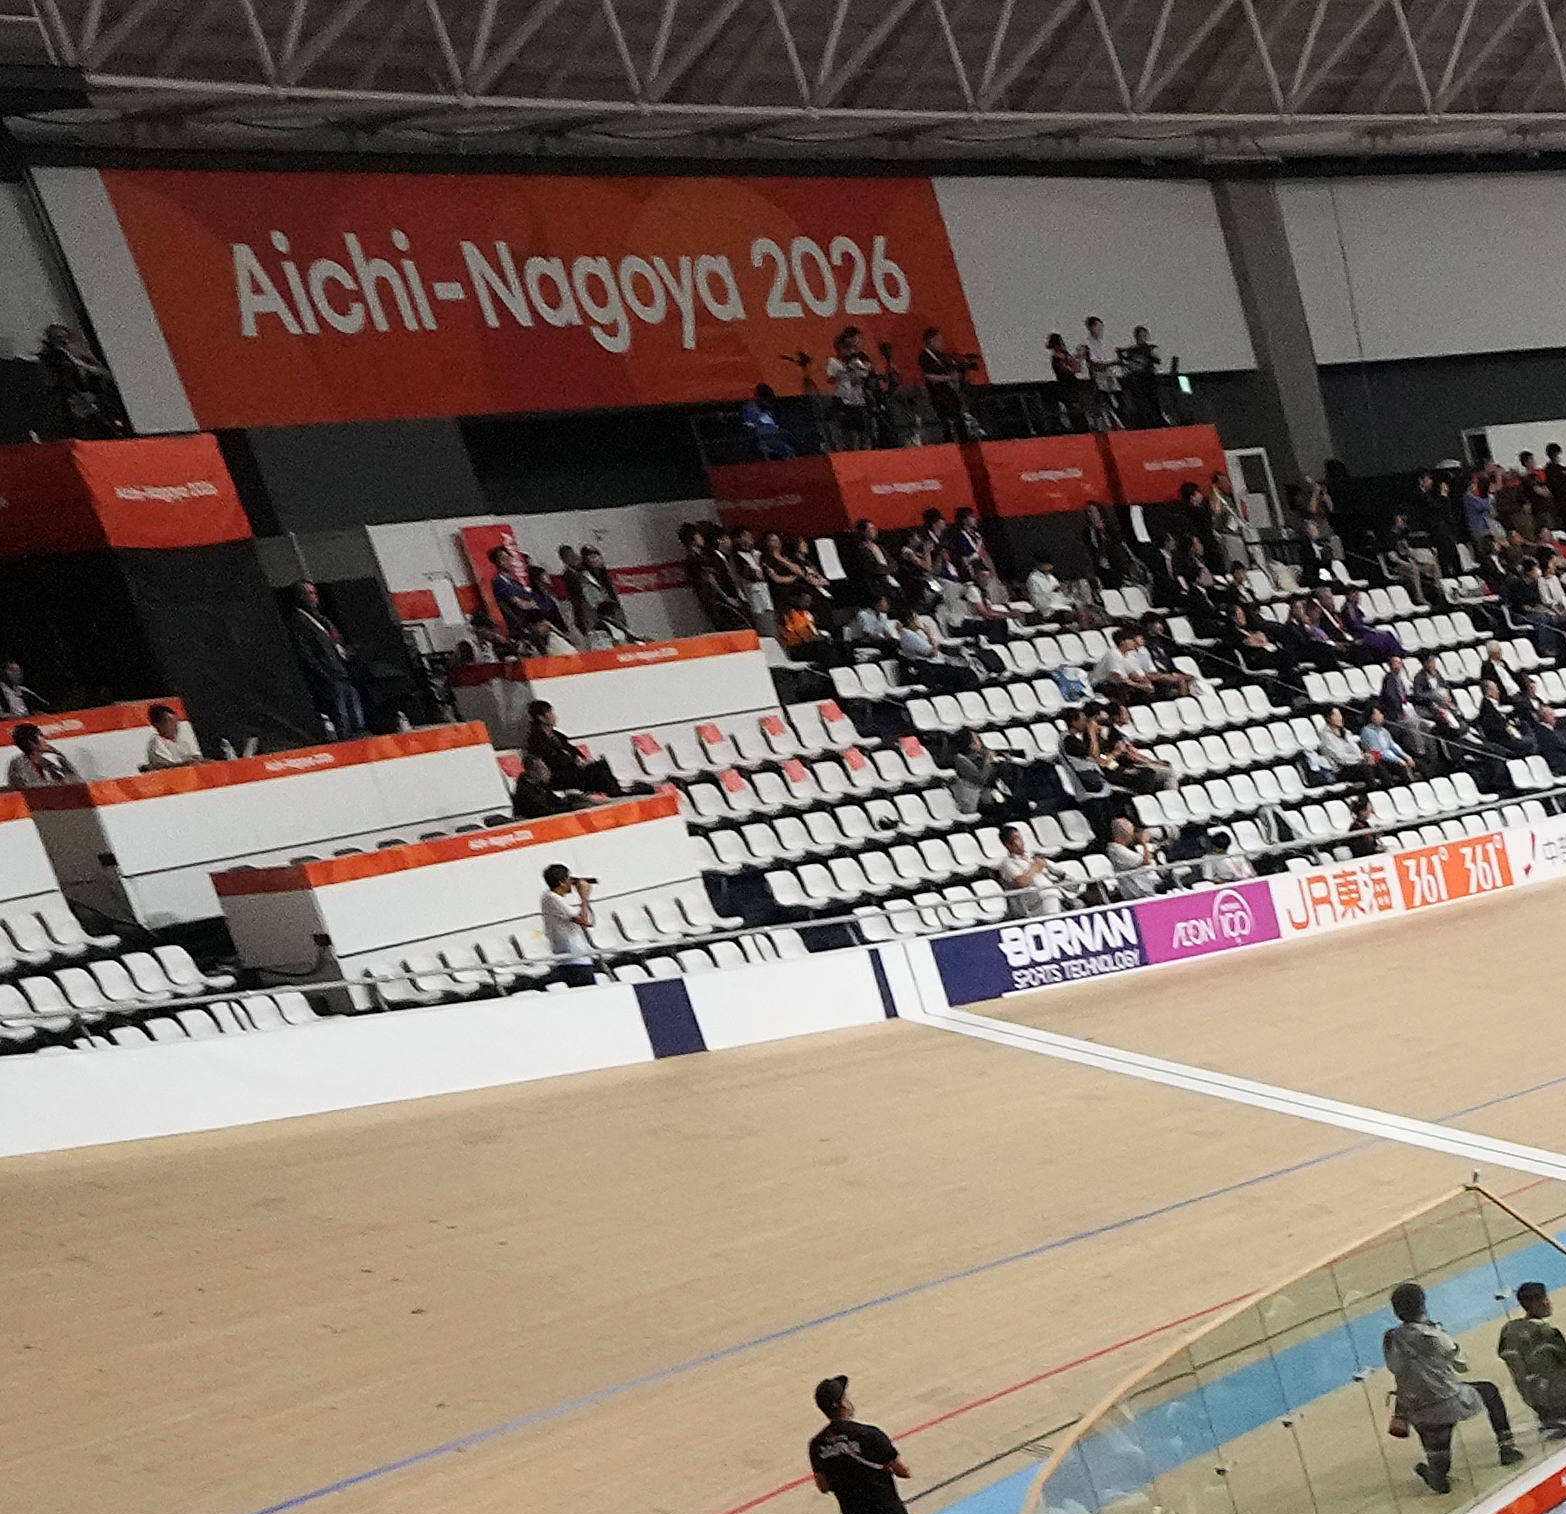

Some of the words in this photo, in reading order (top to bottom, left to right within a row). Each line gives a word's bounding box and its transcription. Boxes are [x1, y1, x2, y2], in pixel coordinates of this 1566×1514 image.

[232, 229, 746, 352] Aichi-Nagoya
[751, 235, 911, 319] 2026
[1287, 863, 1393, 930] JR東海
[1000, 907, 1139, 968] BORNAN
[1012, 963, 1063, 989] SPORTS
[1062, 949, 1141, 979] TECHNOLOGY
